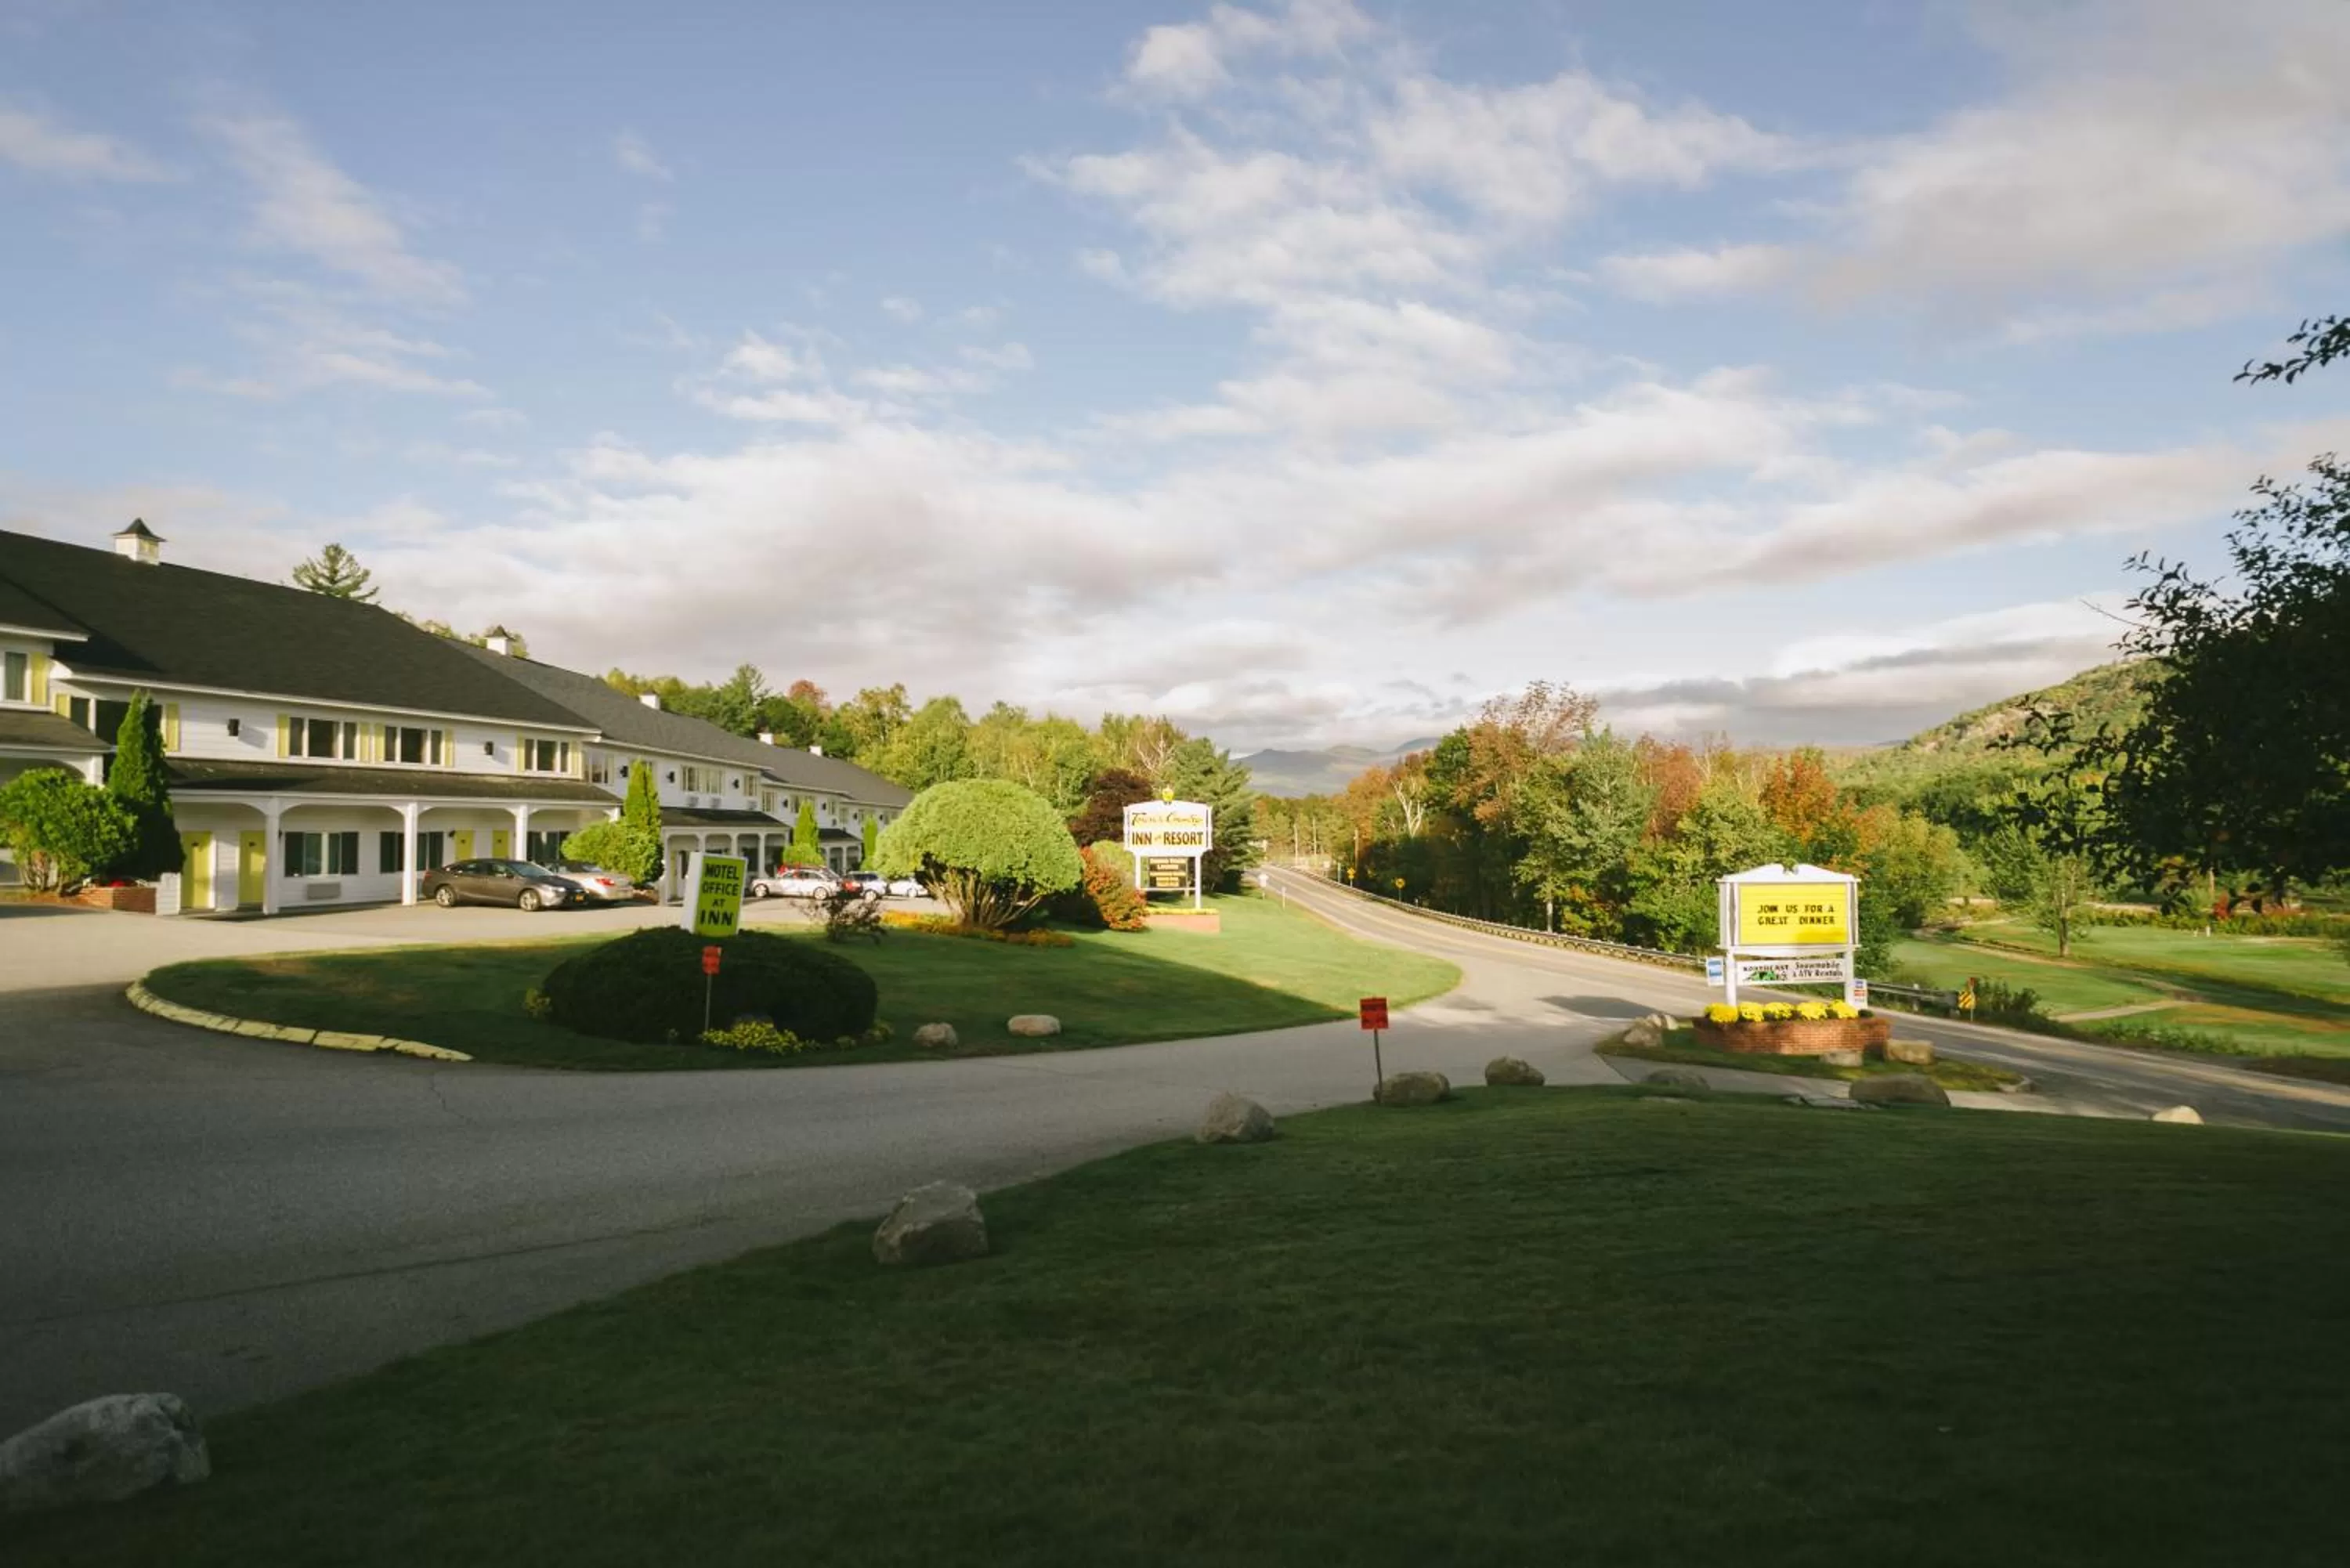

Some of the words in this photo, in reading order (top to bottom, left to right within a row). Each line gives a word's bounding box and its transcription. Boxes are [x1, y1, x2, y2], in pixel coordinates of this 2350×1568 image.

[1132, 832, 1152, 845] INN
[1163, 832, 1203, 845] RESORT
[704, 863, 739, 880] MOTEL
[702, 880, 739, 896] OFFICE
[712, 898, 725, 909] AT
[1786, 905, 1798, 913] US
[700, 909, 734, 927] INN
[1799, 916, 1835, 924] DINNER
